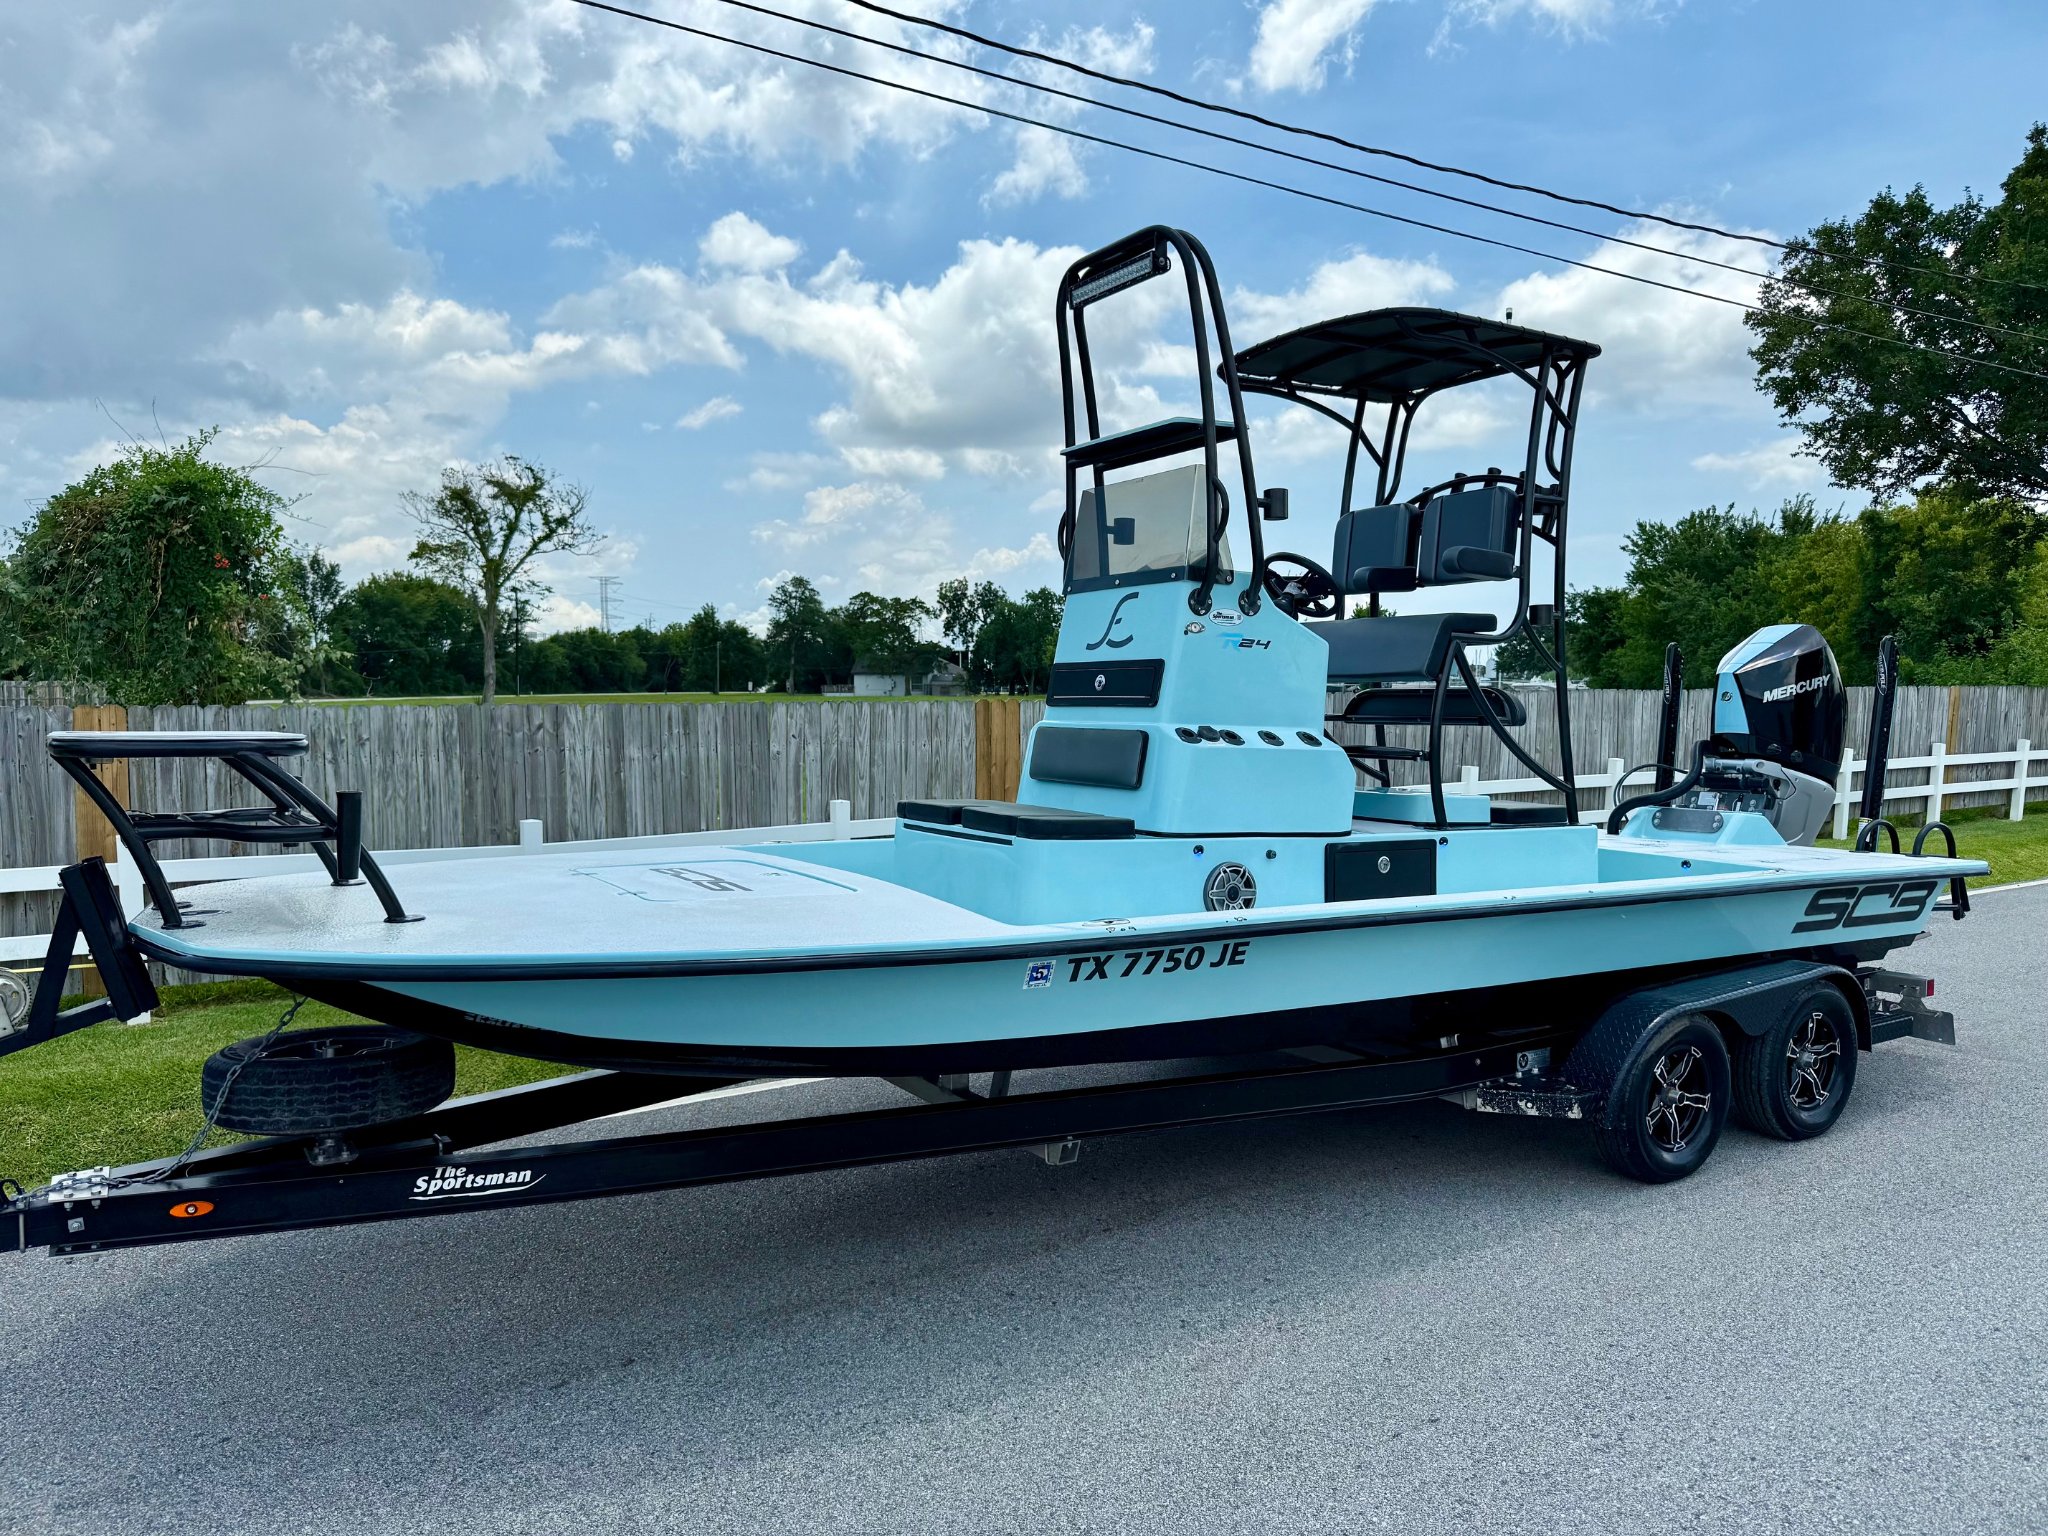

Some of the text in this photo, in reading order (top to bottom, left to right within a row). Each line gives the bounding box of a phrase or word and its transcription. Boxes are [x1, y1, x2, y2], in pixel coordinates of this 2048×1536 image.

[1762, 673, 1831, 703] MERCURY
[1067, 955, 1114, 982] TX
[1119, 945, 1206, 978] 7750
[1209, 941, 1250, 968] JE
[413, 1169, 532, 1195] Sportsman
[435, 1166, 467, 1178] The
